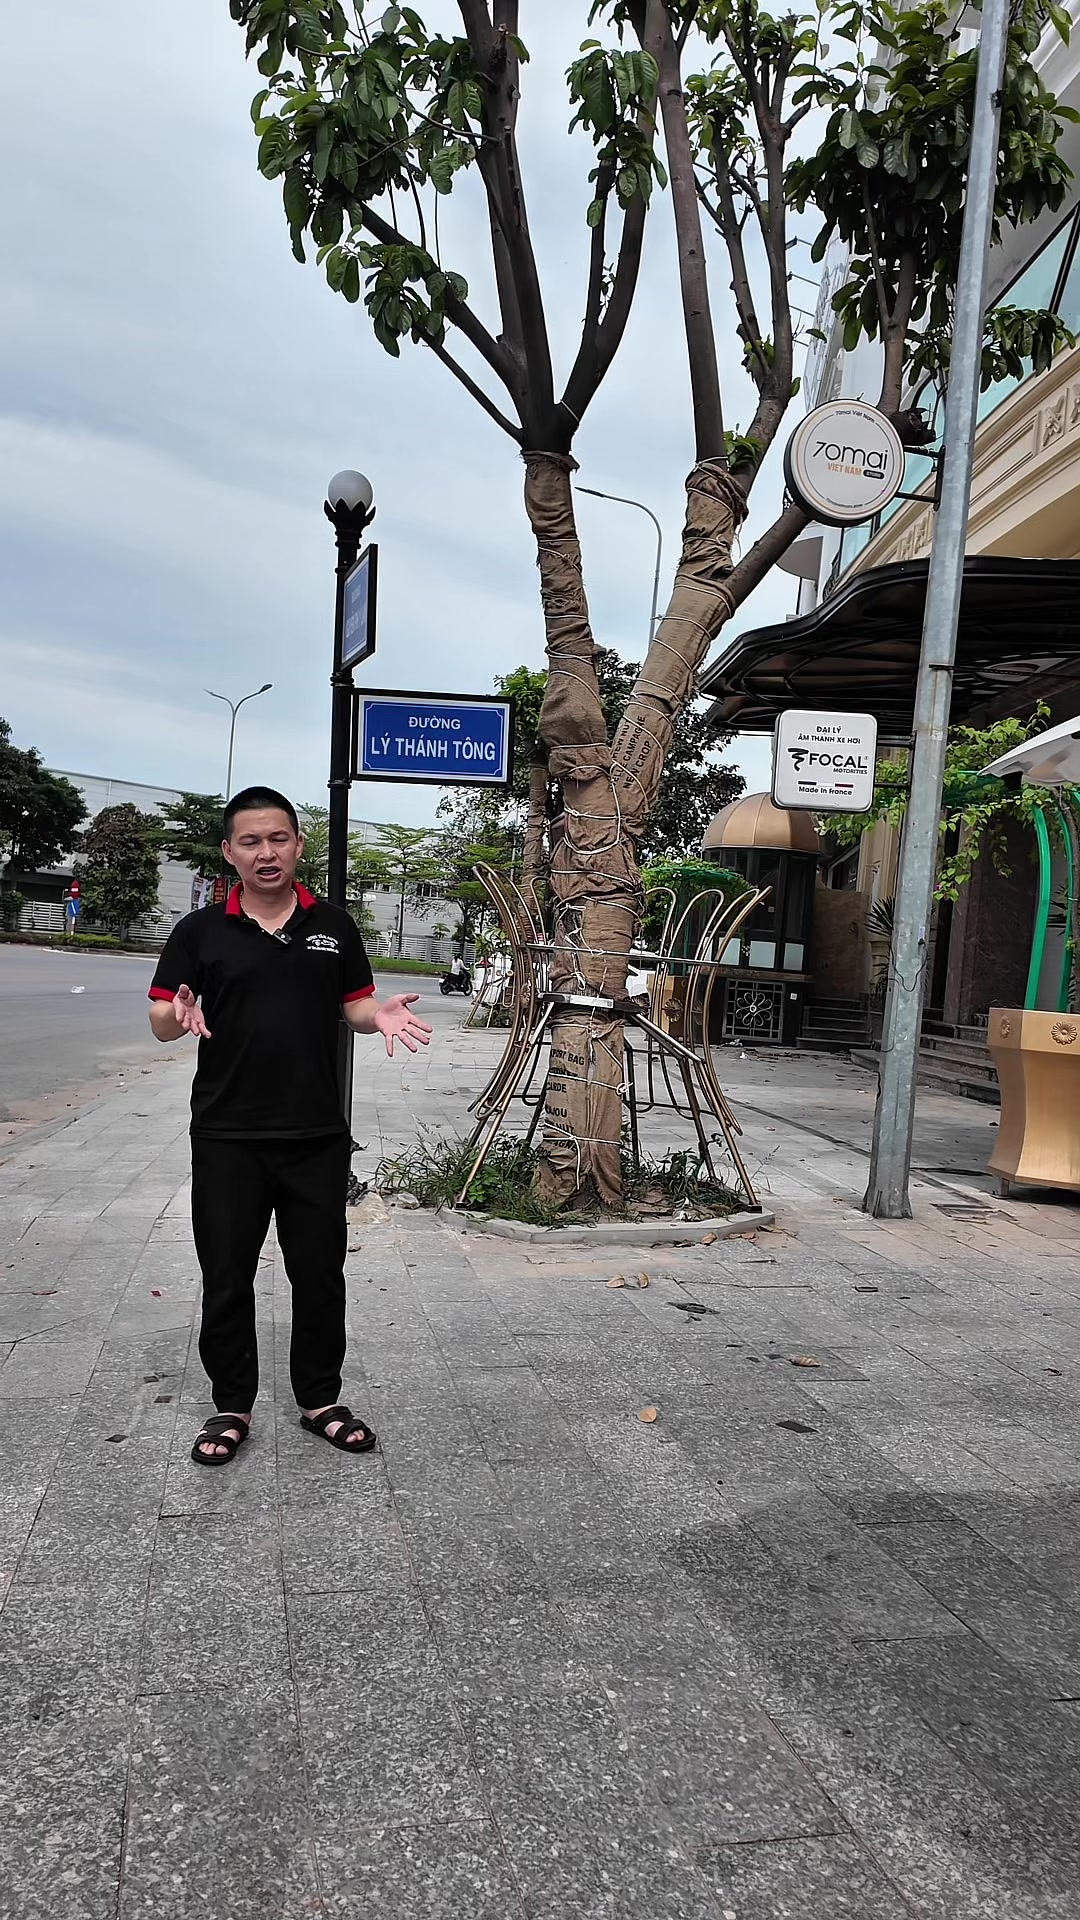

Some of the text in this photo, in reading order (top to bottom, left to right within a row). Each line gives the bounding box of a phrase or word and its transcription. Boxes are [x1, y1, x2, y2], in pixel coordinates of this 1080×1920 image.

[812, 441, 888, 470] 70mai
[845, 464, 862, 476] NAM
[408, 715, 461, 730] ĐƯỜNG
[816, 725, 842, 735] ĐẠI LÝ
[811, 735, 835, 743] THANH
[371, 732, 496, 761] LÝ THÁNH TÔNG
[636, 740, 652, 768] CROP
[809, 752, 868, 769] FOCAL
[798, 786, 819, 794] Made
[828, 788, 853, 796] France
[567, 1053, 585, 1066] BAG
